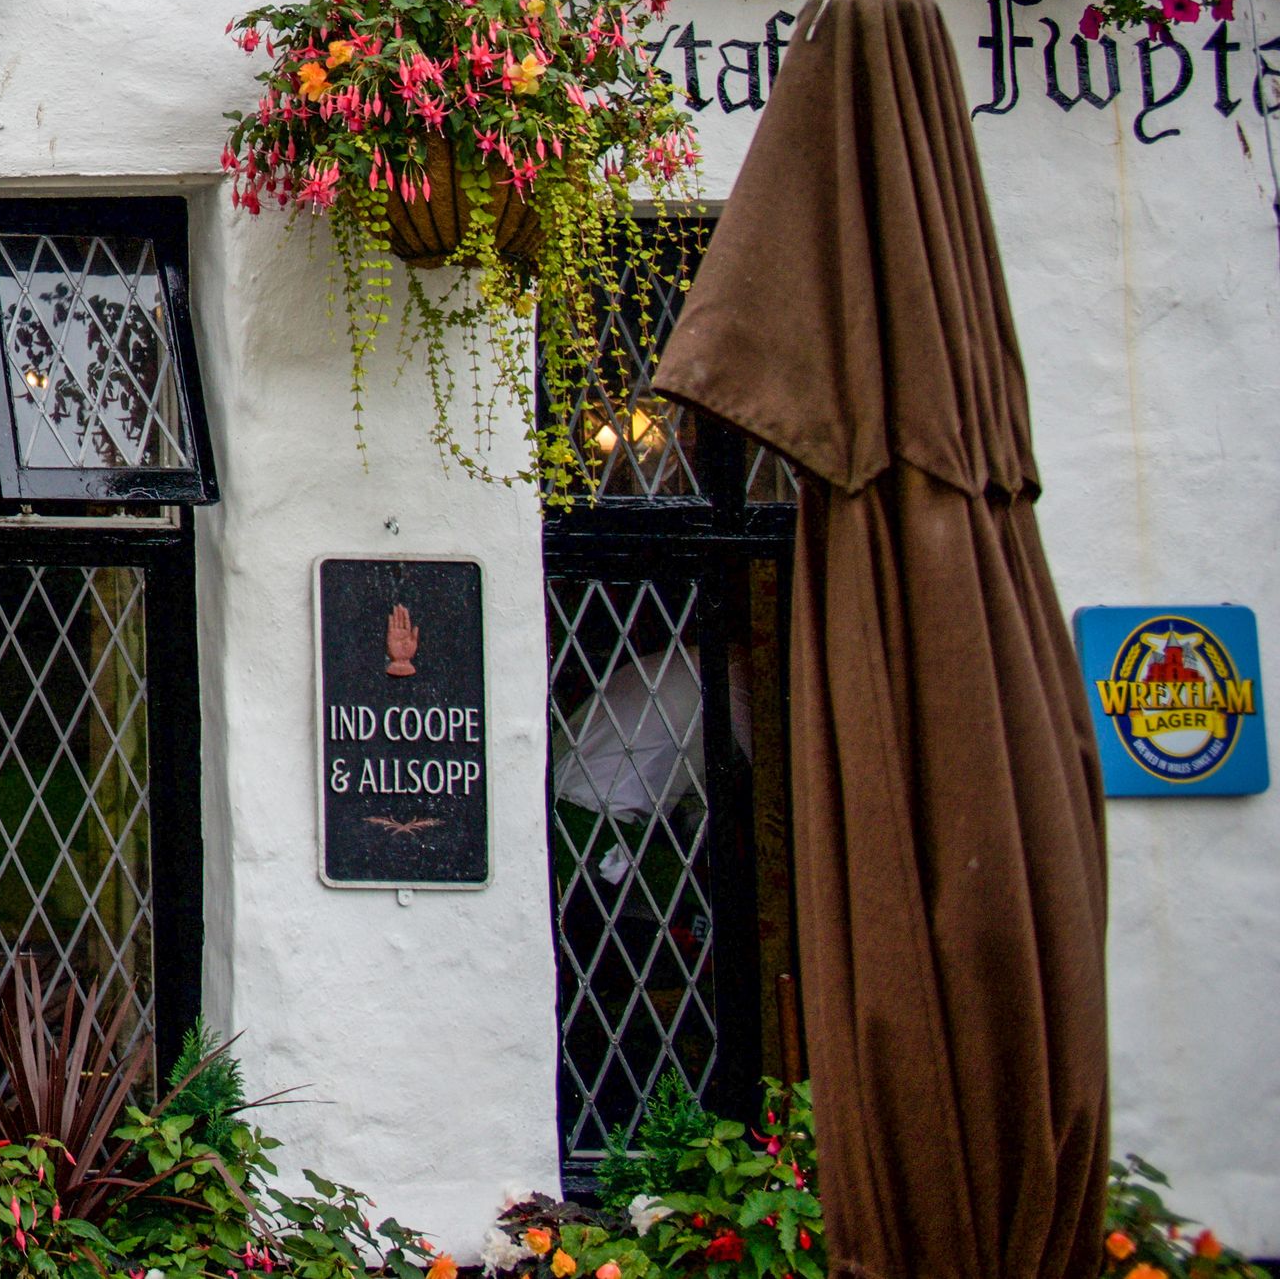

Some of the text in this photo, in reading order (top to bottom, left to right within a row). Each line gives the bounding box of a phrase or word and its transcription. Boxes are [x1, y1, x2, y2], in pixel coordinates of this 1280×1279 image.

[1096, 679, 1256, 715] WREXHAM
[329, 705, 480, 743] IND COOPE
[1145, 712, 1207, 732] LAGER
[1132, 738, 1159, 767] BREWED
[1157, 758, 1167, 770] IN
[1167, 762, 1191, 774] WALES
[1191, 752, 1213, 771] SINCE
[331, 758, 481, 795] & ALLSOPP
